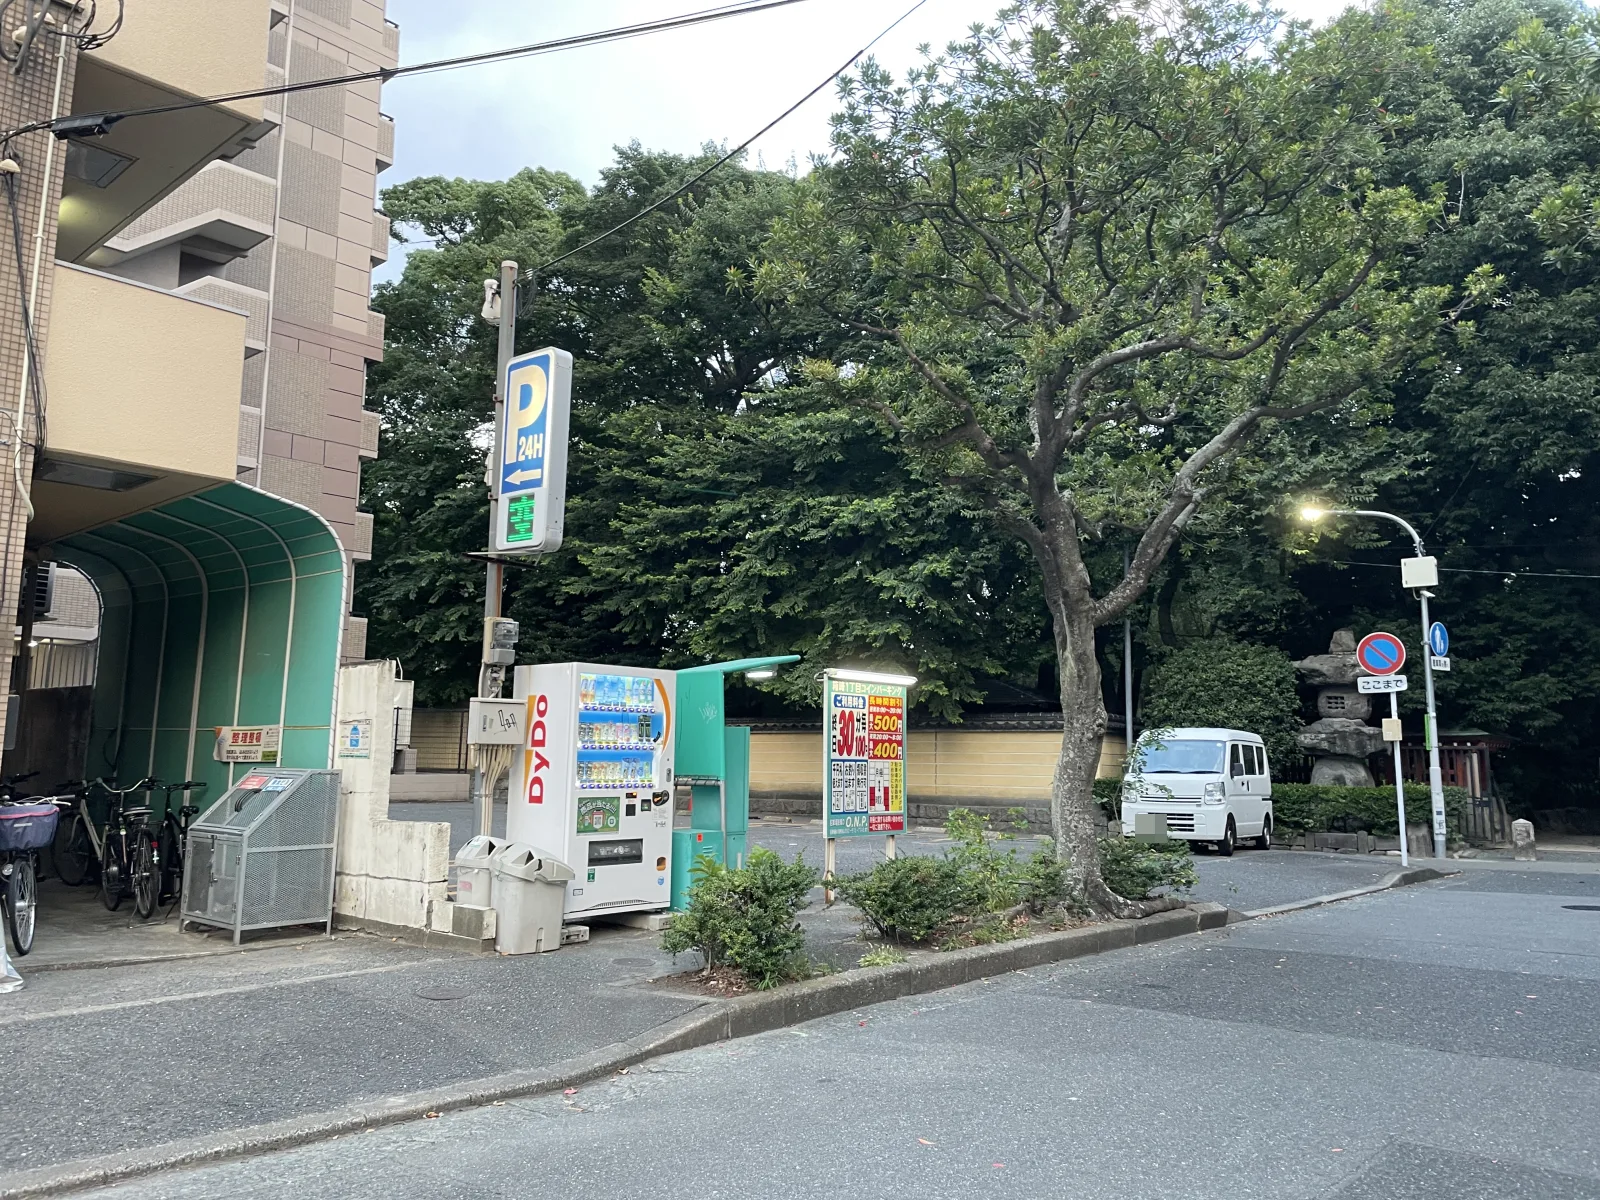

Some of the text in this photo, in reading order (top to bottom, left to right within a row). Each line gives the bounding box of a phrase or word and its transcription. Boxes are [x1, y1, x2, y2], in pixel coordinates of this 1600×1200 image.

[505, 364, 547, 465] P
[517, 433, 543, 462] 24H
[1361, 679, 1405, 690] ここまで
[836, 696, 864, 708] ご利用料金
[869, 696, 902, 707] 長時間割引
